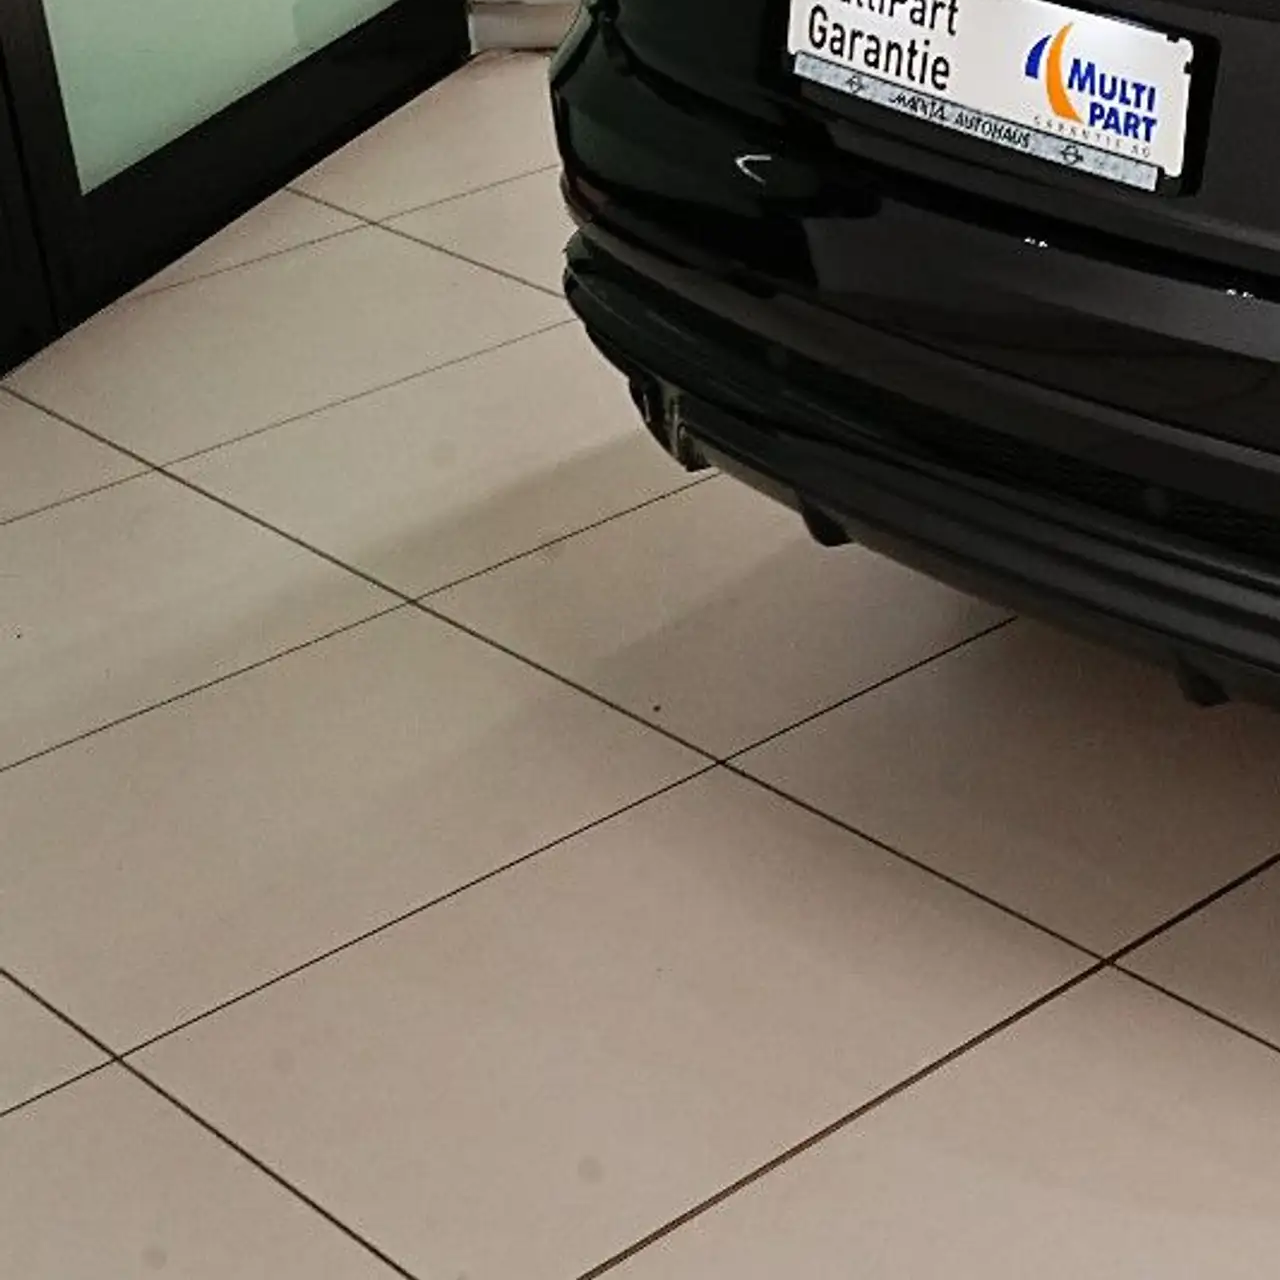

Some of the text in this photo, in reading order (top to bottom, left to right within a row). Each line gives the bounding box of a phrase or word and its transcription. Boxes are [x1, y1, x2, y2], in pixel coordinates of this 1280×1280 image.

[807, 4, 952, 91] Garantie
[1066, 57, 1157, 112] MULTI
[953, 111, 1032, 150] AUTOHAUS
[1088, 101, 1158, 143] PART
